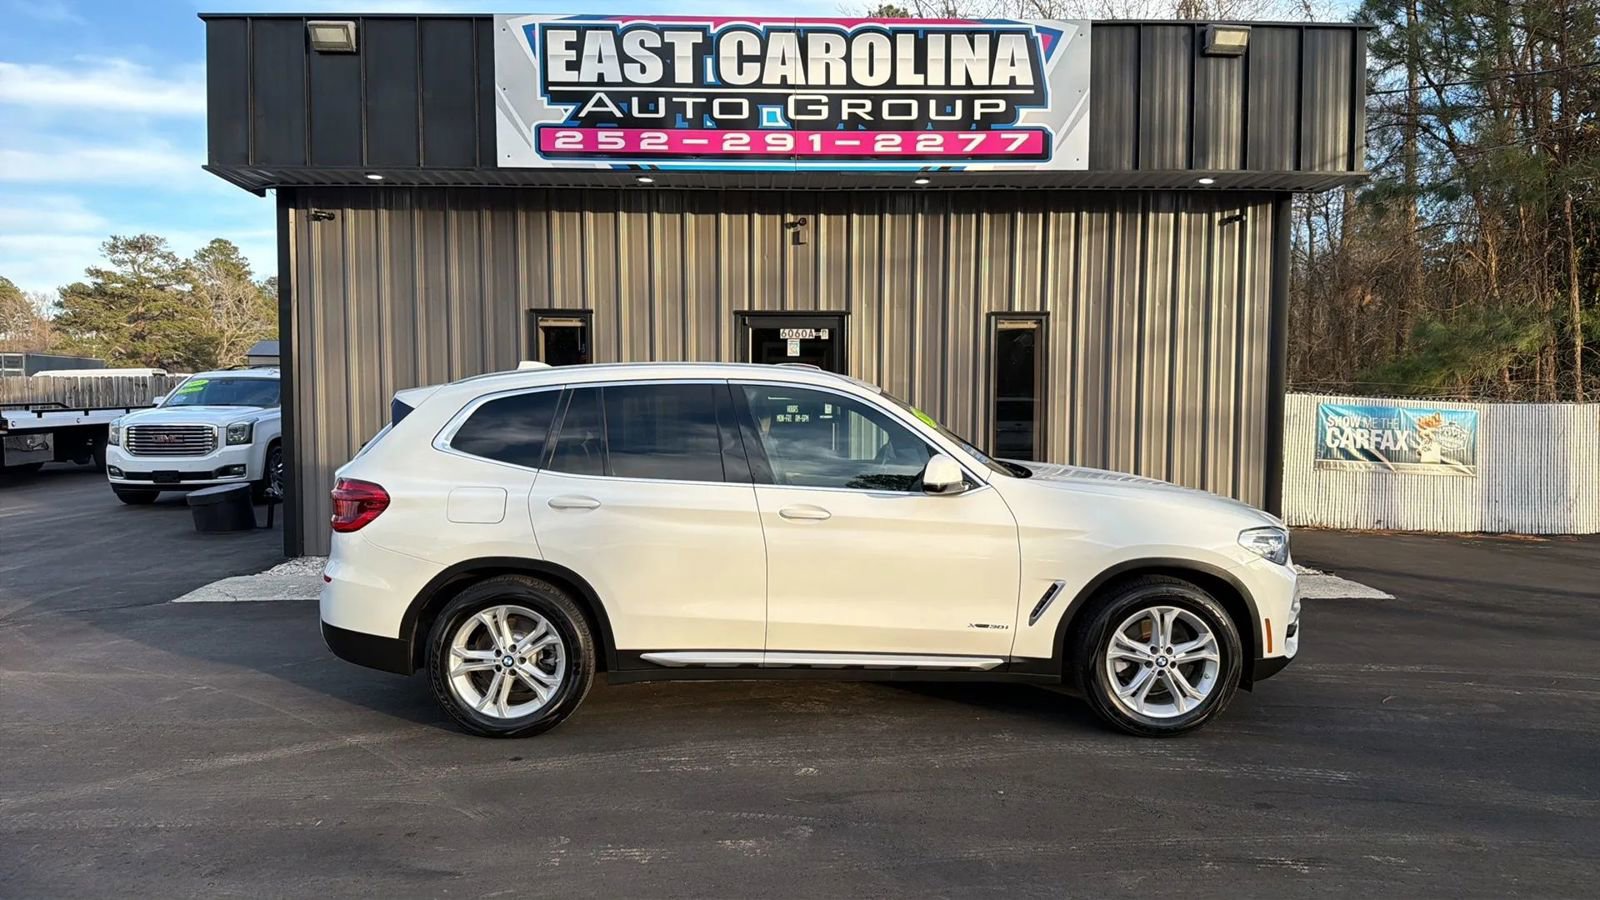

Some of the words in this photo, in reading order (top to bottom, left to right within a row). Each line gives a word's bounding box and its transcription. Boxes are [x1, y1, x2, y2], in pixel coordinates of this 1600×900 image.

[546, 29, 703, 85] EAST
[718, 32, 1034, 87] CAROLINA
[555, 132, 1031, 152] 252-291-2277
[1327, 415, 1362, 428] SHOW
[1364, 417, 1378, 429] ME
[1382, 417, 1400, 430] THE
[1325, 428, 1409, 451] CARFAX
